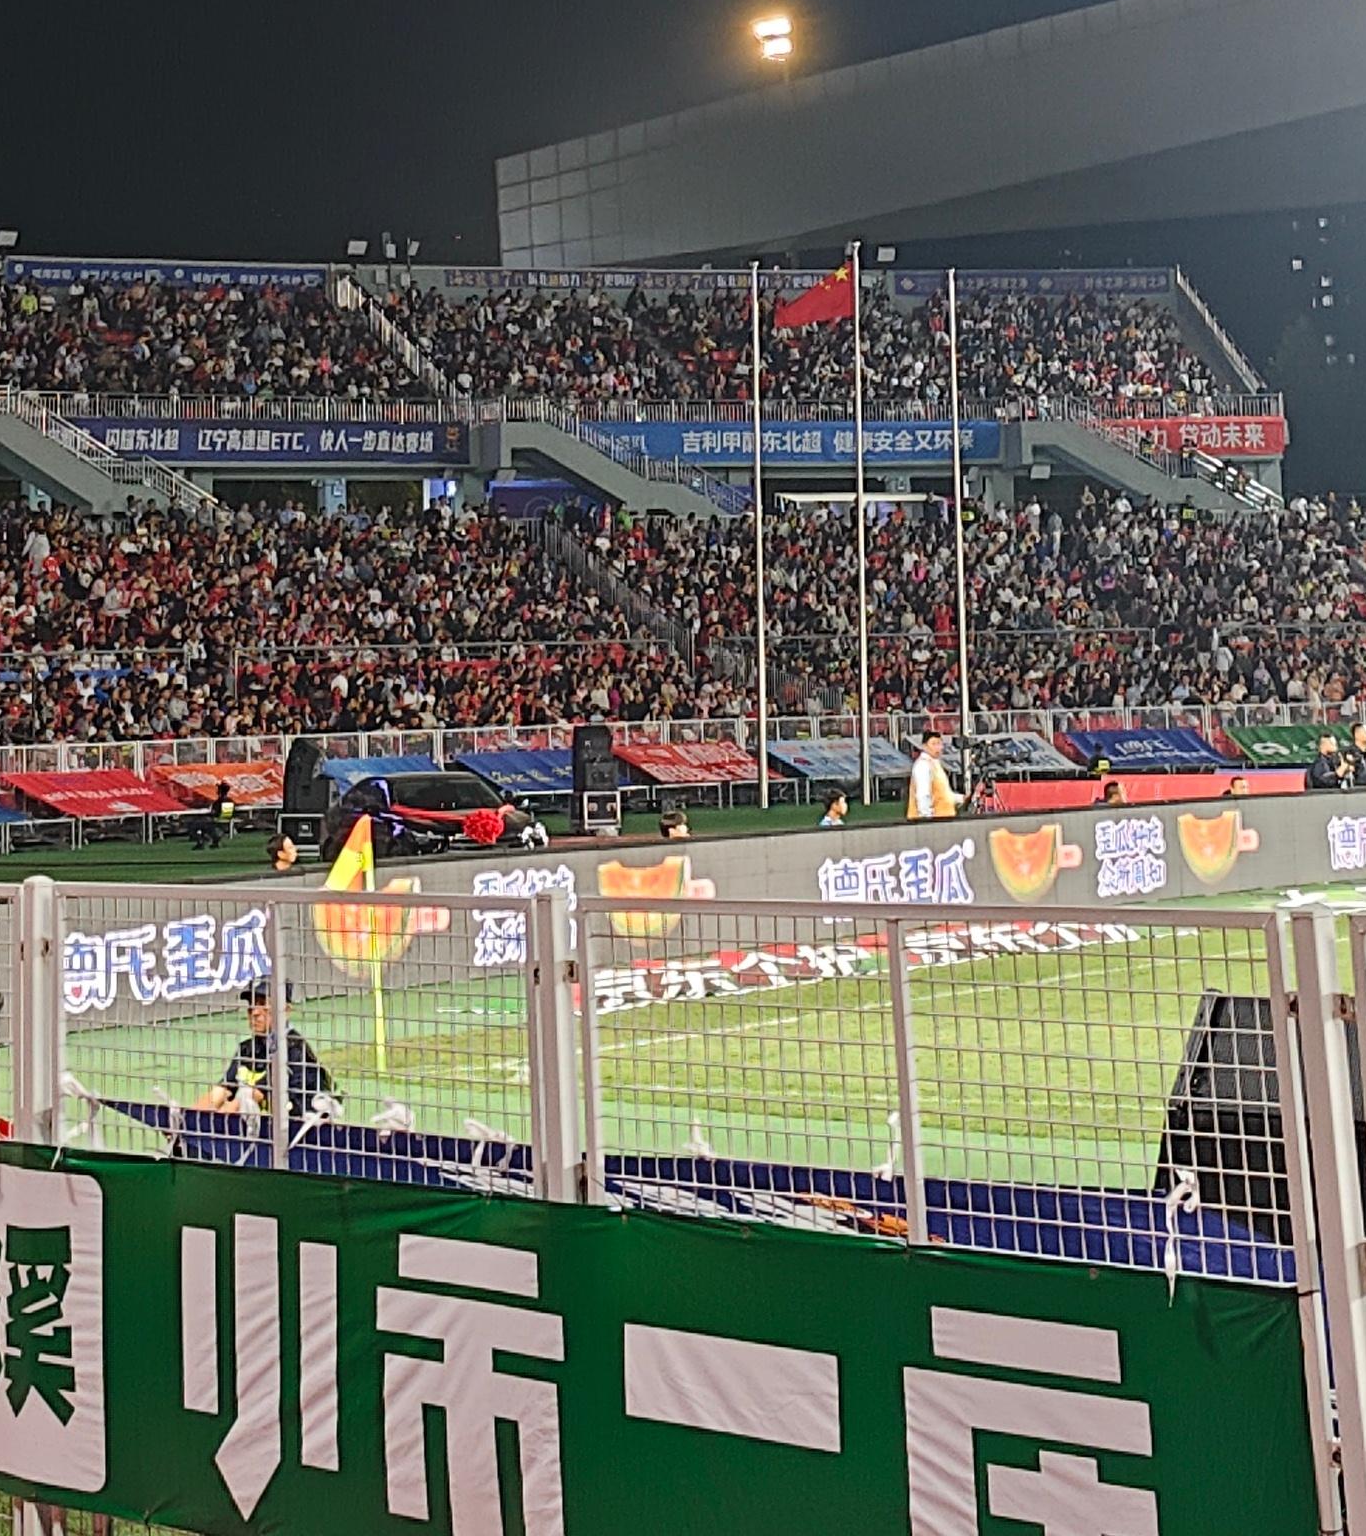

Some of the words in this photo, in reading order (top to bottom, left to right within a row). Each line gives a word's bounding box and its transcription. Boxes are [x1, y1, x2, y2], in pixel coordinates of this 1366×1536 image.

[105, 427, 180, 452] 闪耀东北超
[181, 1213, 1160, 1536] 小市一庄
